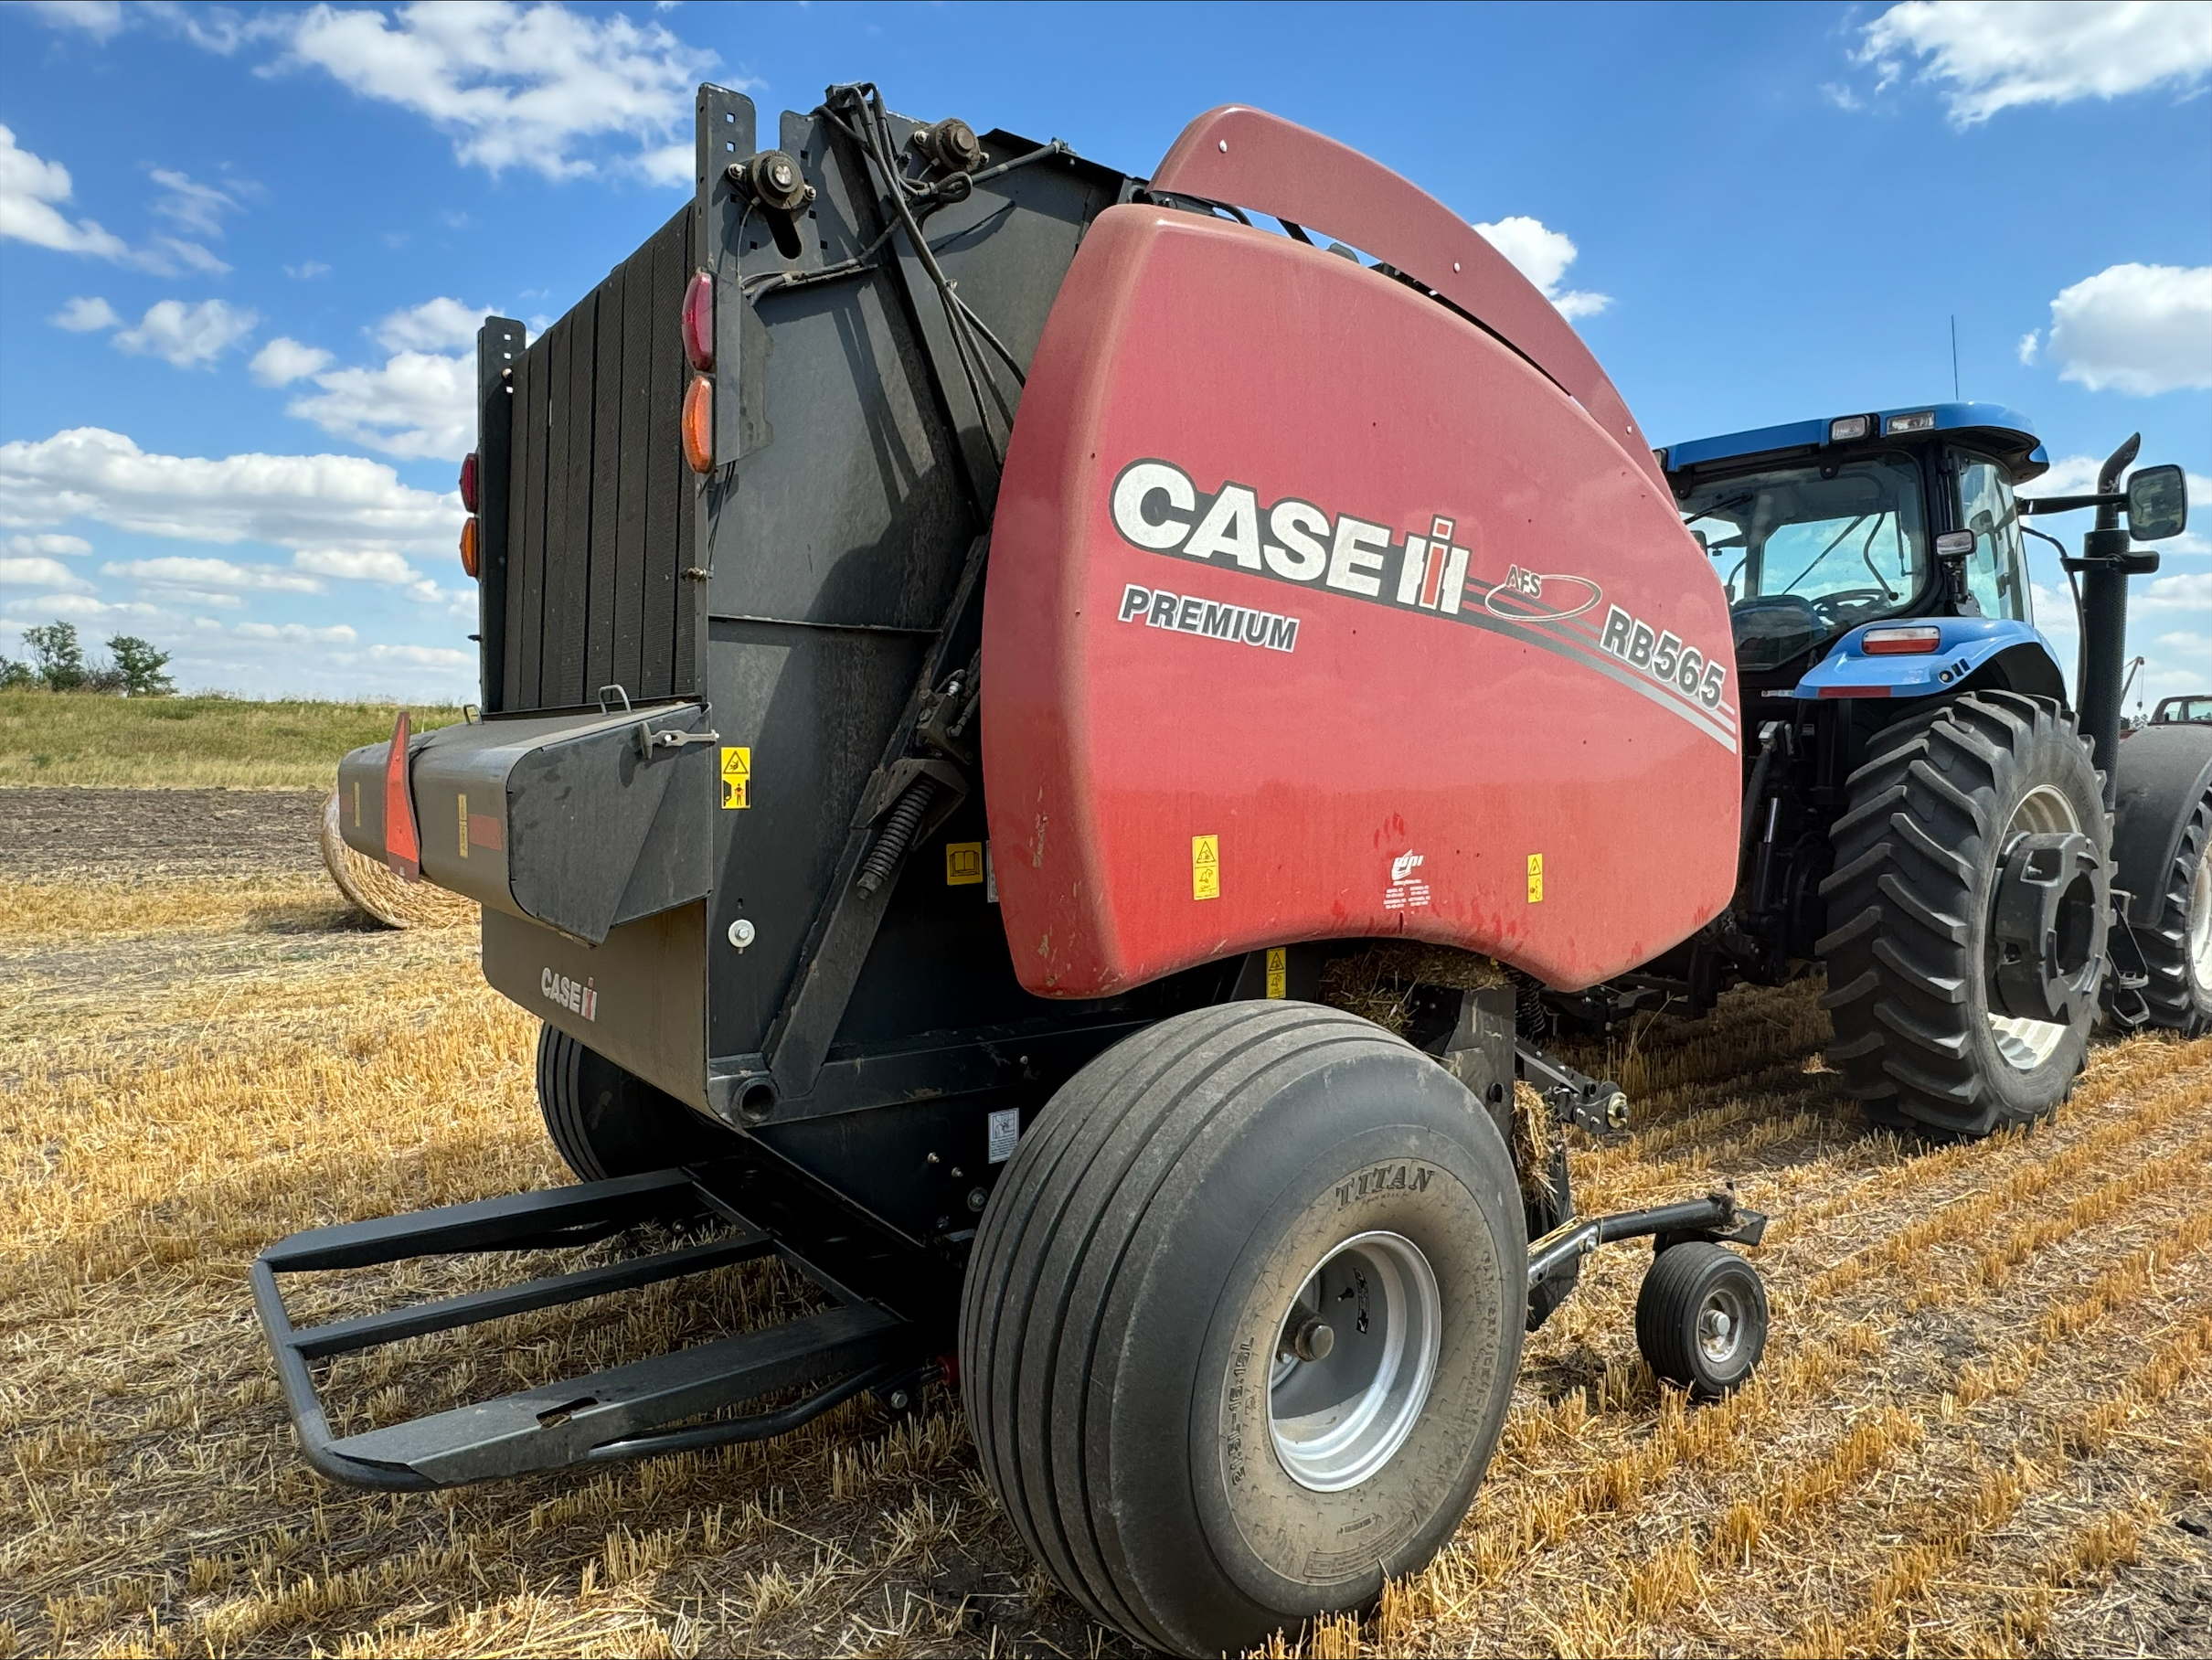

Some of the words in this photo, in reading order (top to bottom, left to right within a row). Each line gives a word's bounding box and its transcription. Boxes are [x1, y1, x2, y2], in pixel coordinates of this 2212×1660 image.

[1112, 463, 1391, 598] CASE
[1505, 563, 1541, 599] AFS
[1118, 584, 1300, 653] PREMIUM
[1600, 603, 1727, 711] RB565
[541, 966, 581, 1014] CASE
[1335, 1165, 1435, 1212] TITAN
